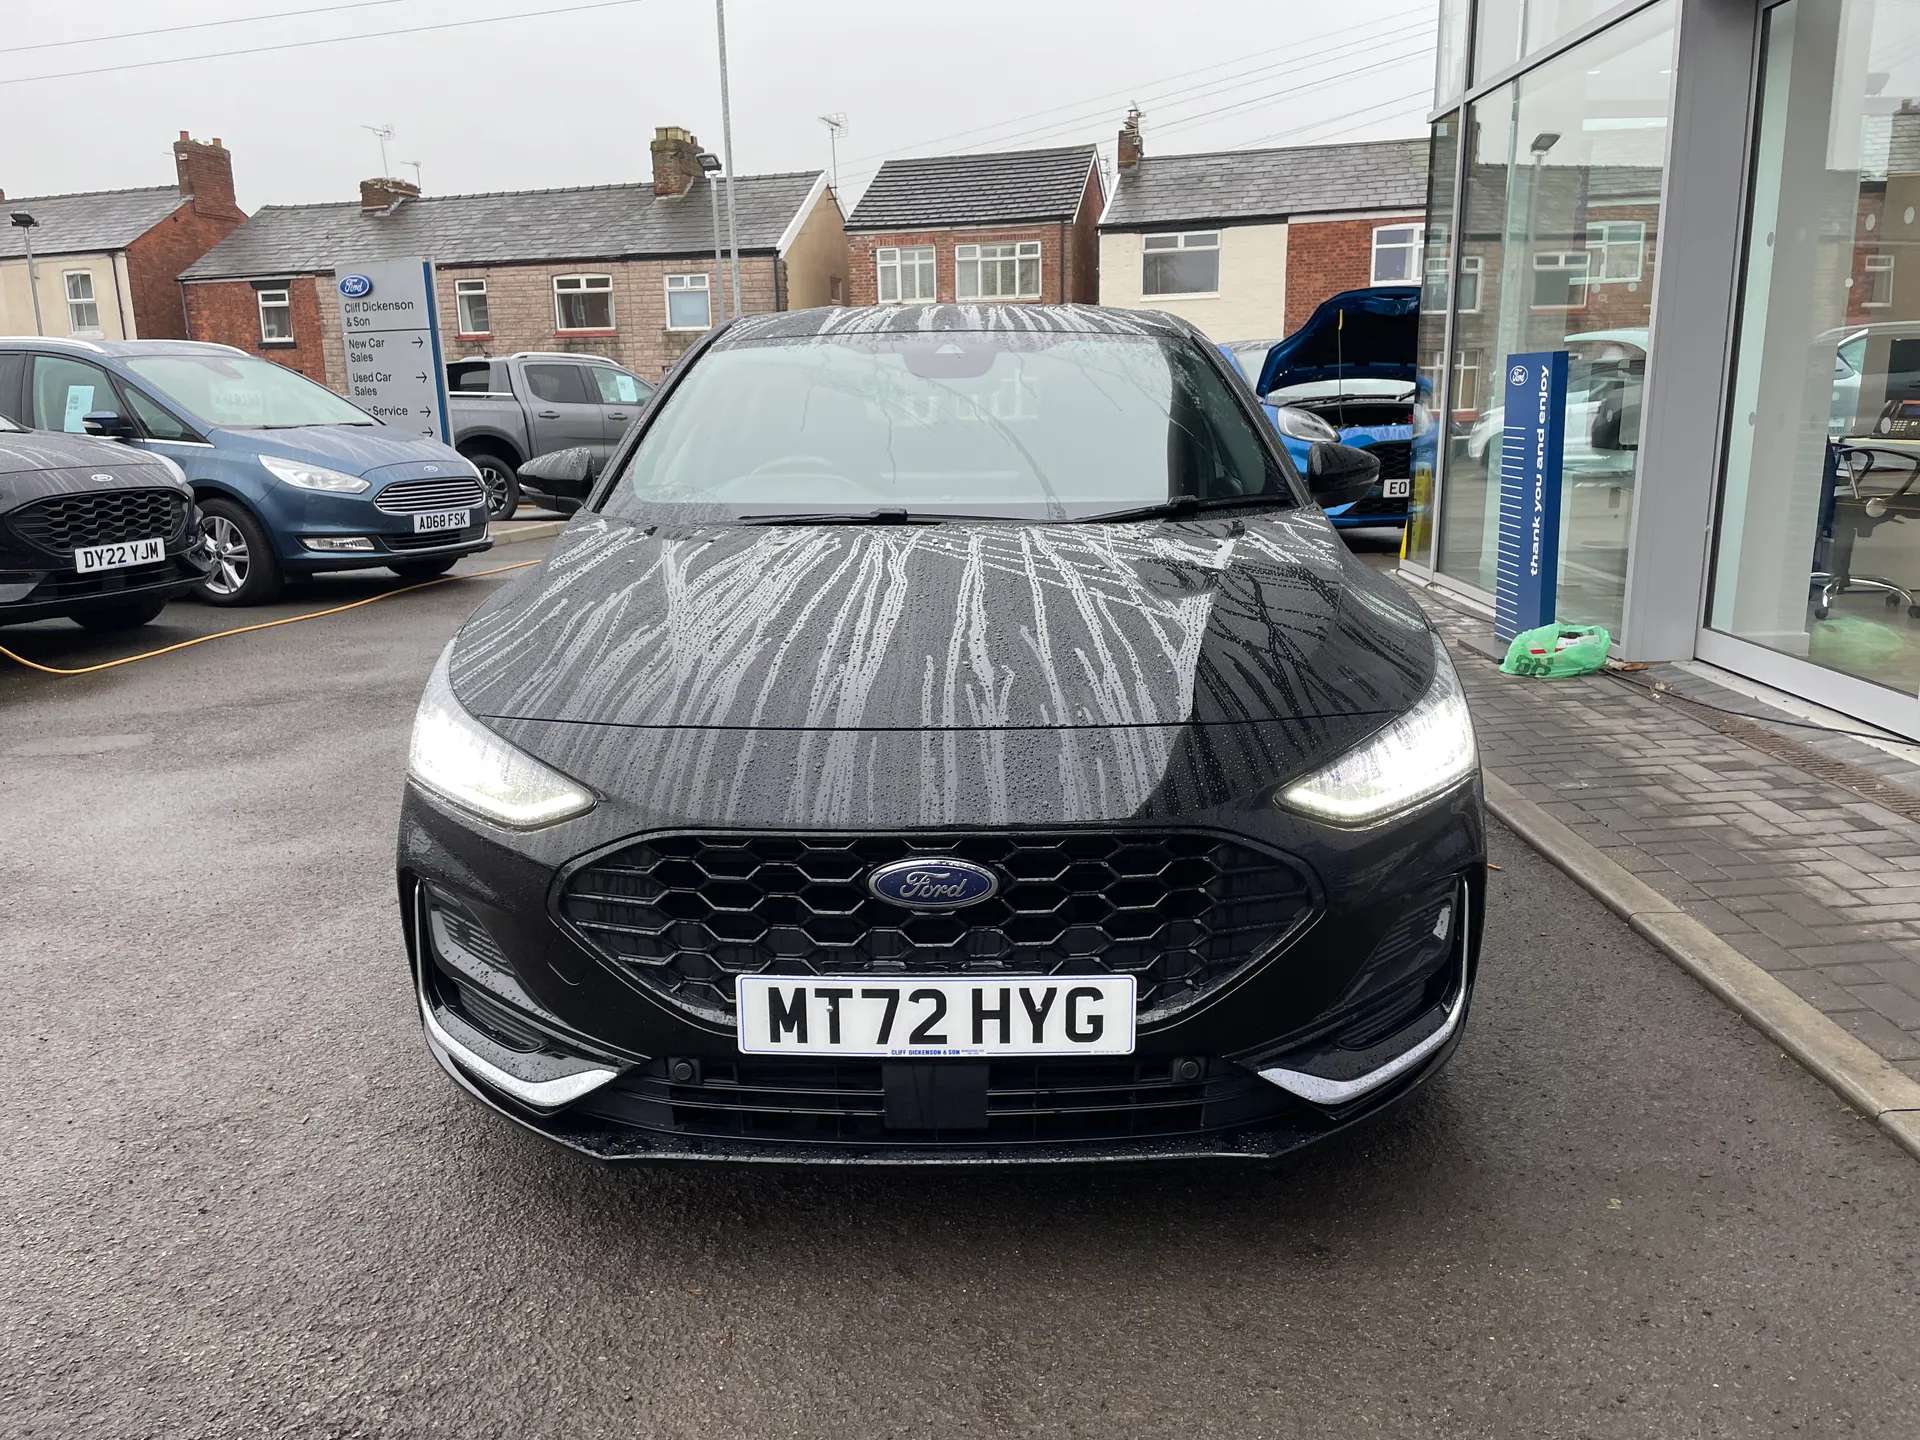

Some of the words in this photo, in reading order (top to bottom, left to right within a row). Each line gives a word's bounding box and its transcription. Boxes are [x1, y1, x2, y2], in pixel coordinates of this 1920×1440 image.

[345, 302, 361, 313] Cliff
[362, 300, 414, 312] Dickenson
[346, 318, 353, 327] &
[353, 316, 371, 327] Son
[349, 338, 367, 349] New
[368, 337, 385, 348] Car
[350, 352, 374, 363] Sales
[352, 372, 374, 383] Used
[375, 371, 392, 382] Car
[354, 386, 378, 397] Sales
[1538, 365, 1549, 424] enjoy
[373, 406, 409, 417] Service
[1535, 428, 1545, 470] and
[1533, 472, 1545, 513] you
[419, 514, 446, 530] AD68
[447, 512, 466, 526] FSK
[83, 547, 127, 568] DY22
[130, 541, 159, 561] YJM
[1530, 517, 1542, 576] thank
[899, 871, 968, 898] Ford
[767, 986, 947, 1045] MT72
[972, 986, 1104, 1044] HYG
